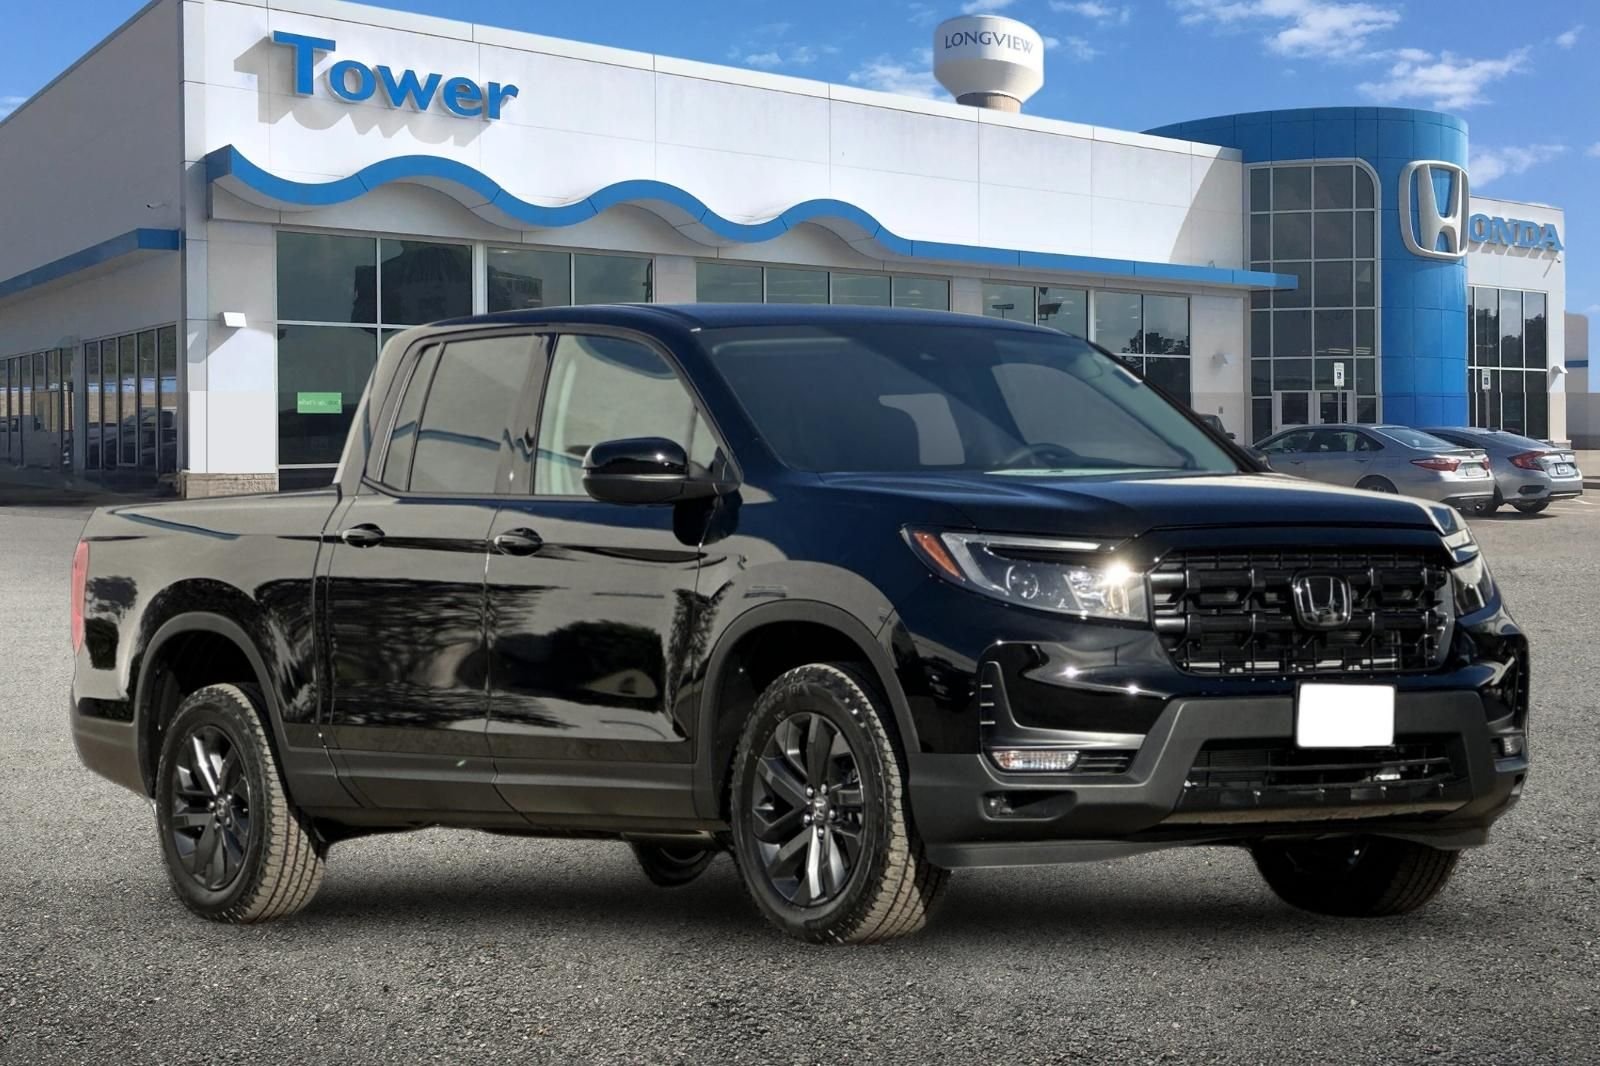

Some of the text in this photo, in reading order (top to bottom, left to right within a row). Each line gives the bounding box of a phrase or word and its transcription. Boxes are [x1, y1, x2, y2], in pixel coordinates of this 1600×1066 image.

[945, 31, 1034, 54] LONGVIEW
[273, 30, 519, 120] Tower
[1470, 213, 1564, 251] ONDA
